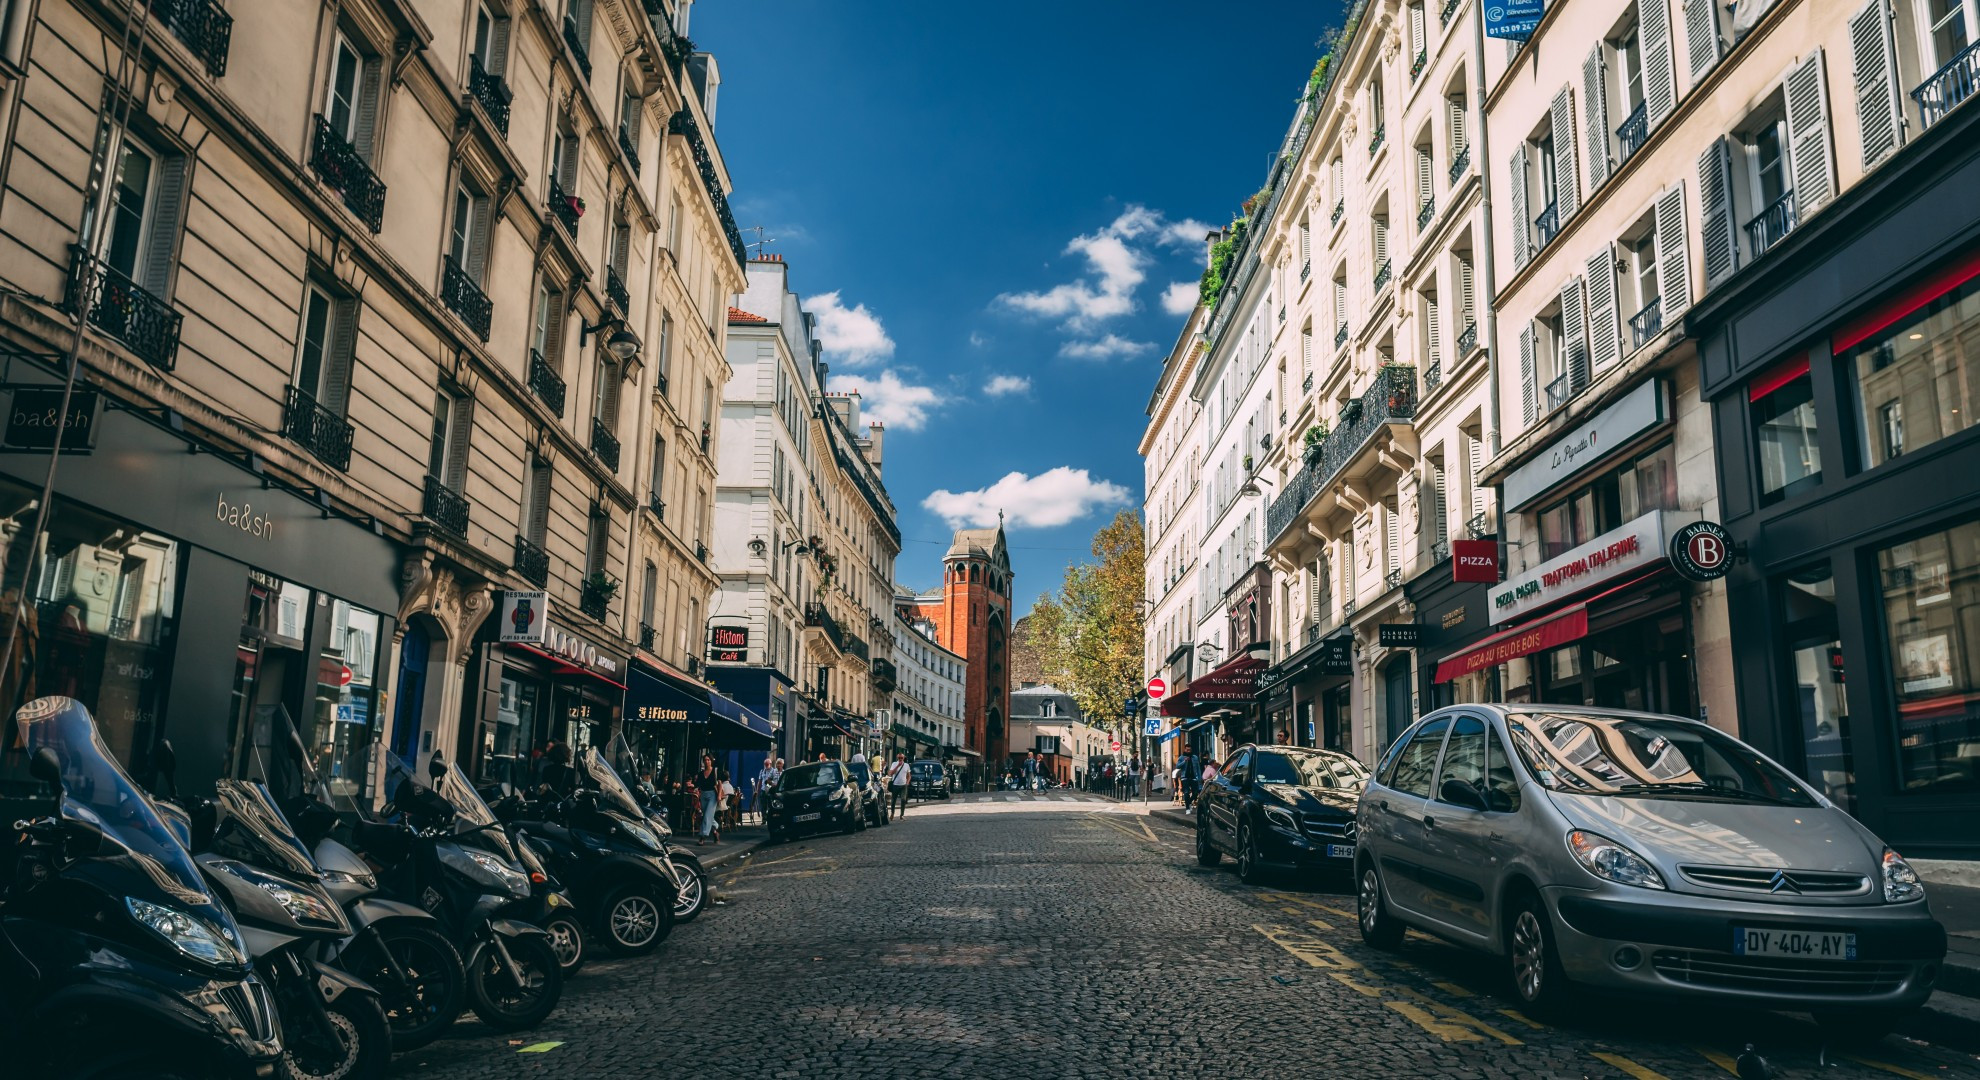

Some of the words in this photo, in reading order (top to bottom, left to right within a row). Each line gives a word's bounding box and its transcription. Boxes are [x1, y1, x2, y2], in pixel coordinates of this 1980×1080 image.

[1489, 27, 1499, 35] 01
[1500, 25, 1510, 33] 53
[1511, 24, 1521, 32] 09
[13, 407, 88, 428] ba&sh
[216, 491, 273, 541] ba&sh
[1685, 524, 1725, 539] BARNES
[1460, 556, 1493, 566] PIZZA
[1588, 535, 1638, 568] ITALIENNE
[1681, 550, 1721, 577] INTERNATIONAL
[505, 591, 545, 599] RESTAURANT
[546, 626, 596, 667] NAOKO
[719, 629, 745, 646] Fistons
[720, 651, 738, 661] Café
[1466, 652, 1484, 670] PIZZA
[1496, 643, 1510, 660] FEU
[1510, 640, 1521, 655] DE
[1521, 632, 1540, 651] BOIS
[652, 706, 688, 720] Fistons
[1748, 931, 1842, 956] DY-404-AY
[1846, 947, 1857, 957] 58
